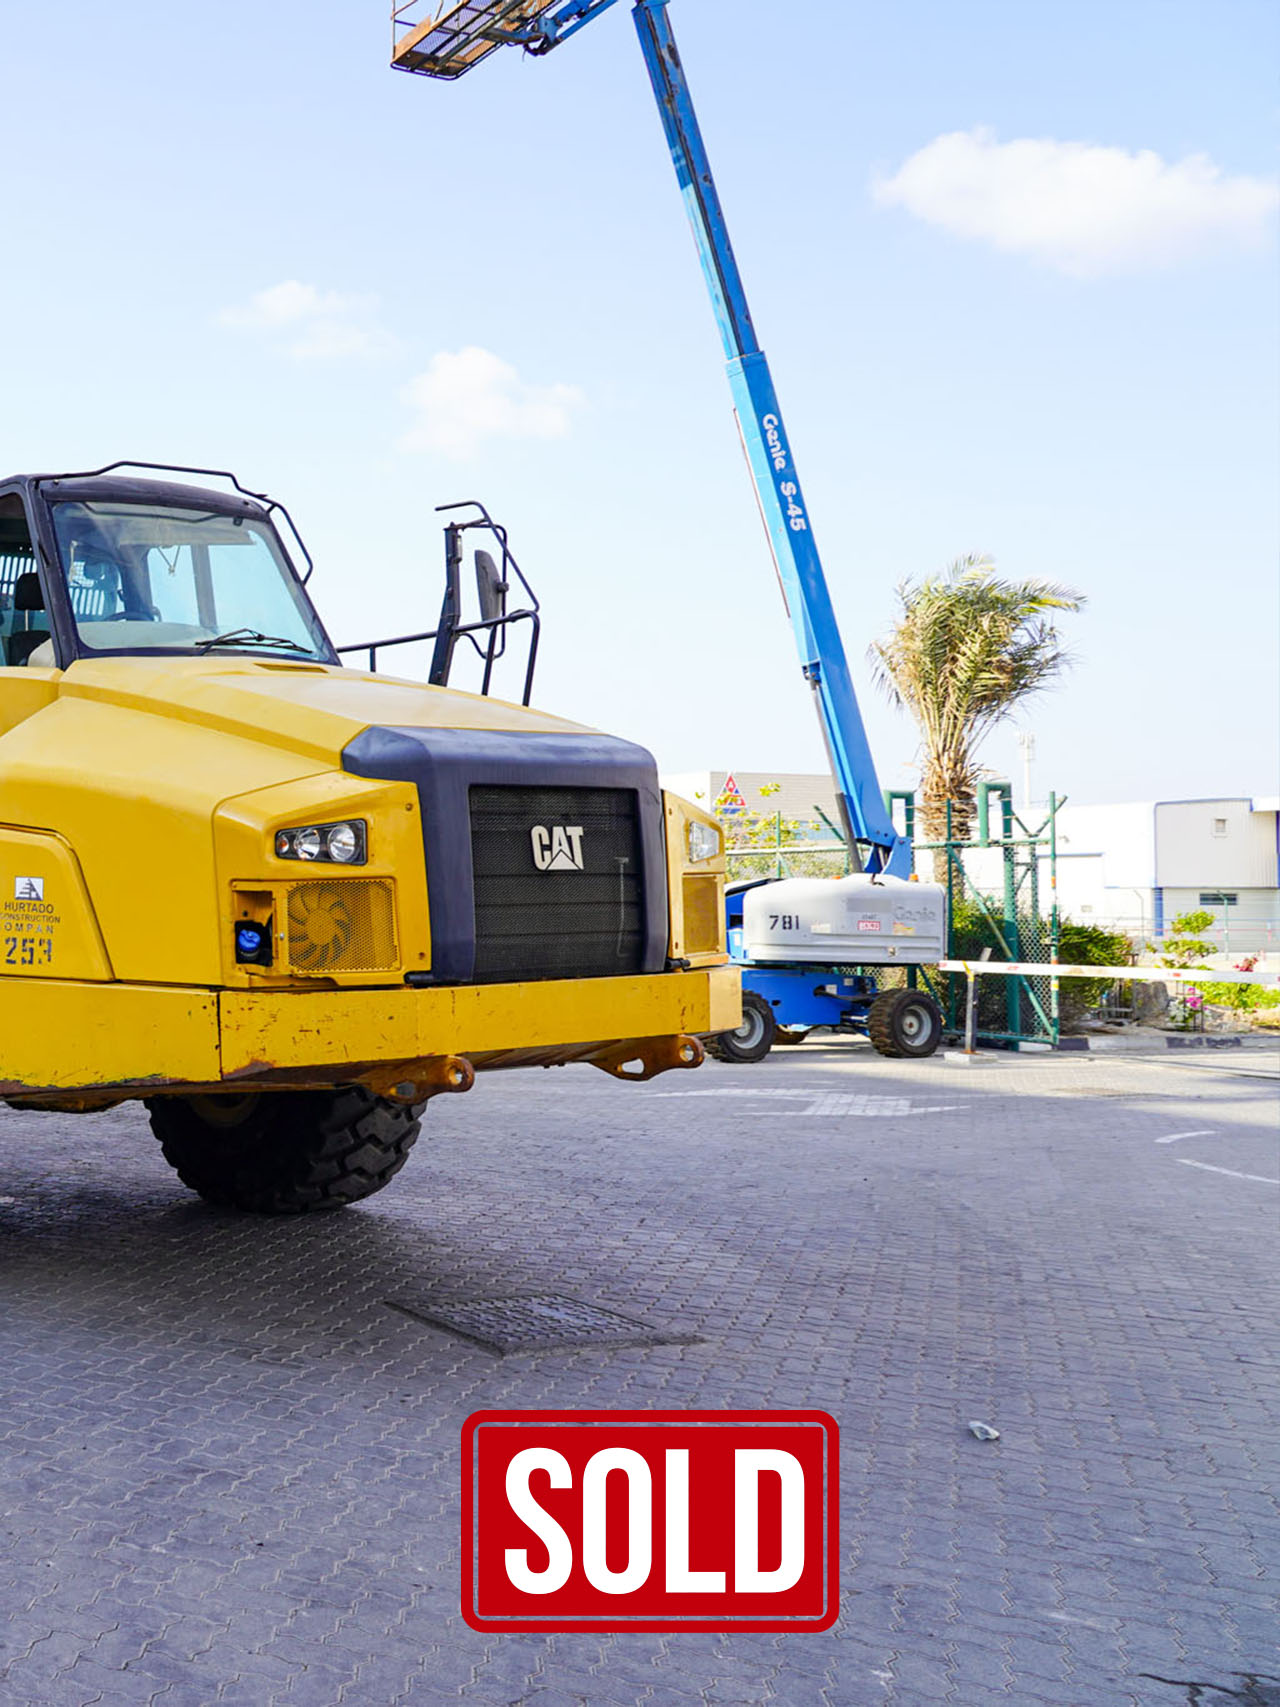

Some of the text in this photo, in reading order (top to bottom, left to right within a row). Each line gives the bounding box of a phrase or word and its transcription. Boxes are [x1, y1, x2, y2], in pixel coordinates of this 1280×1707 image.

[763, 413, 807, 532] Genie S-45
[531, 825, 584, 870] CAT
[4, 902, 54, 914] HURTADO
[769, 915, 800, 930] 781
